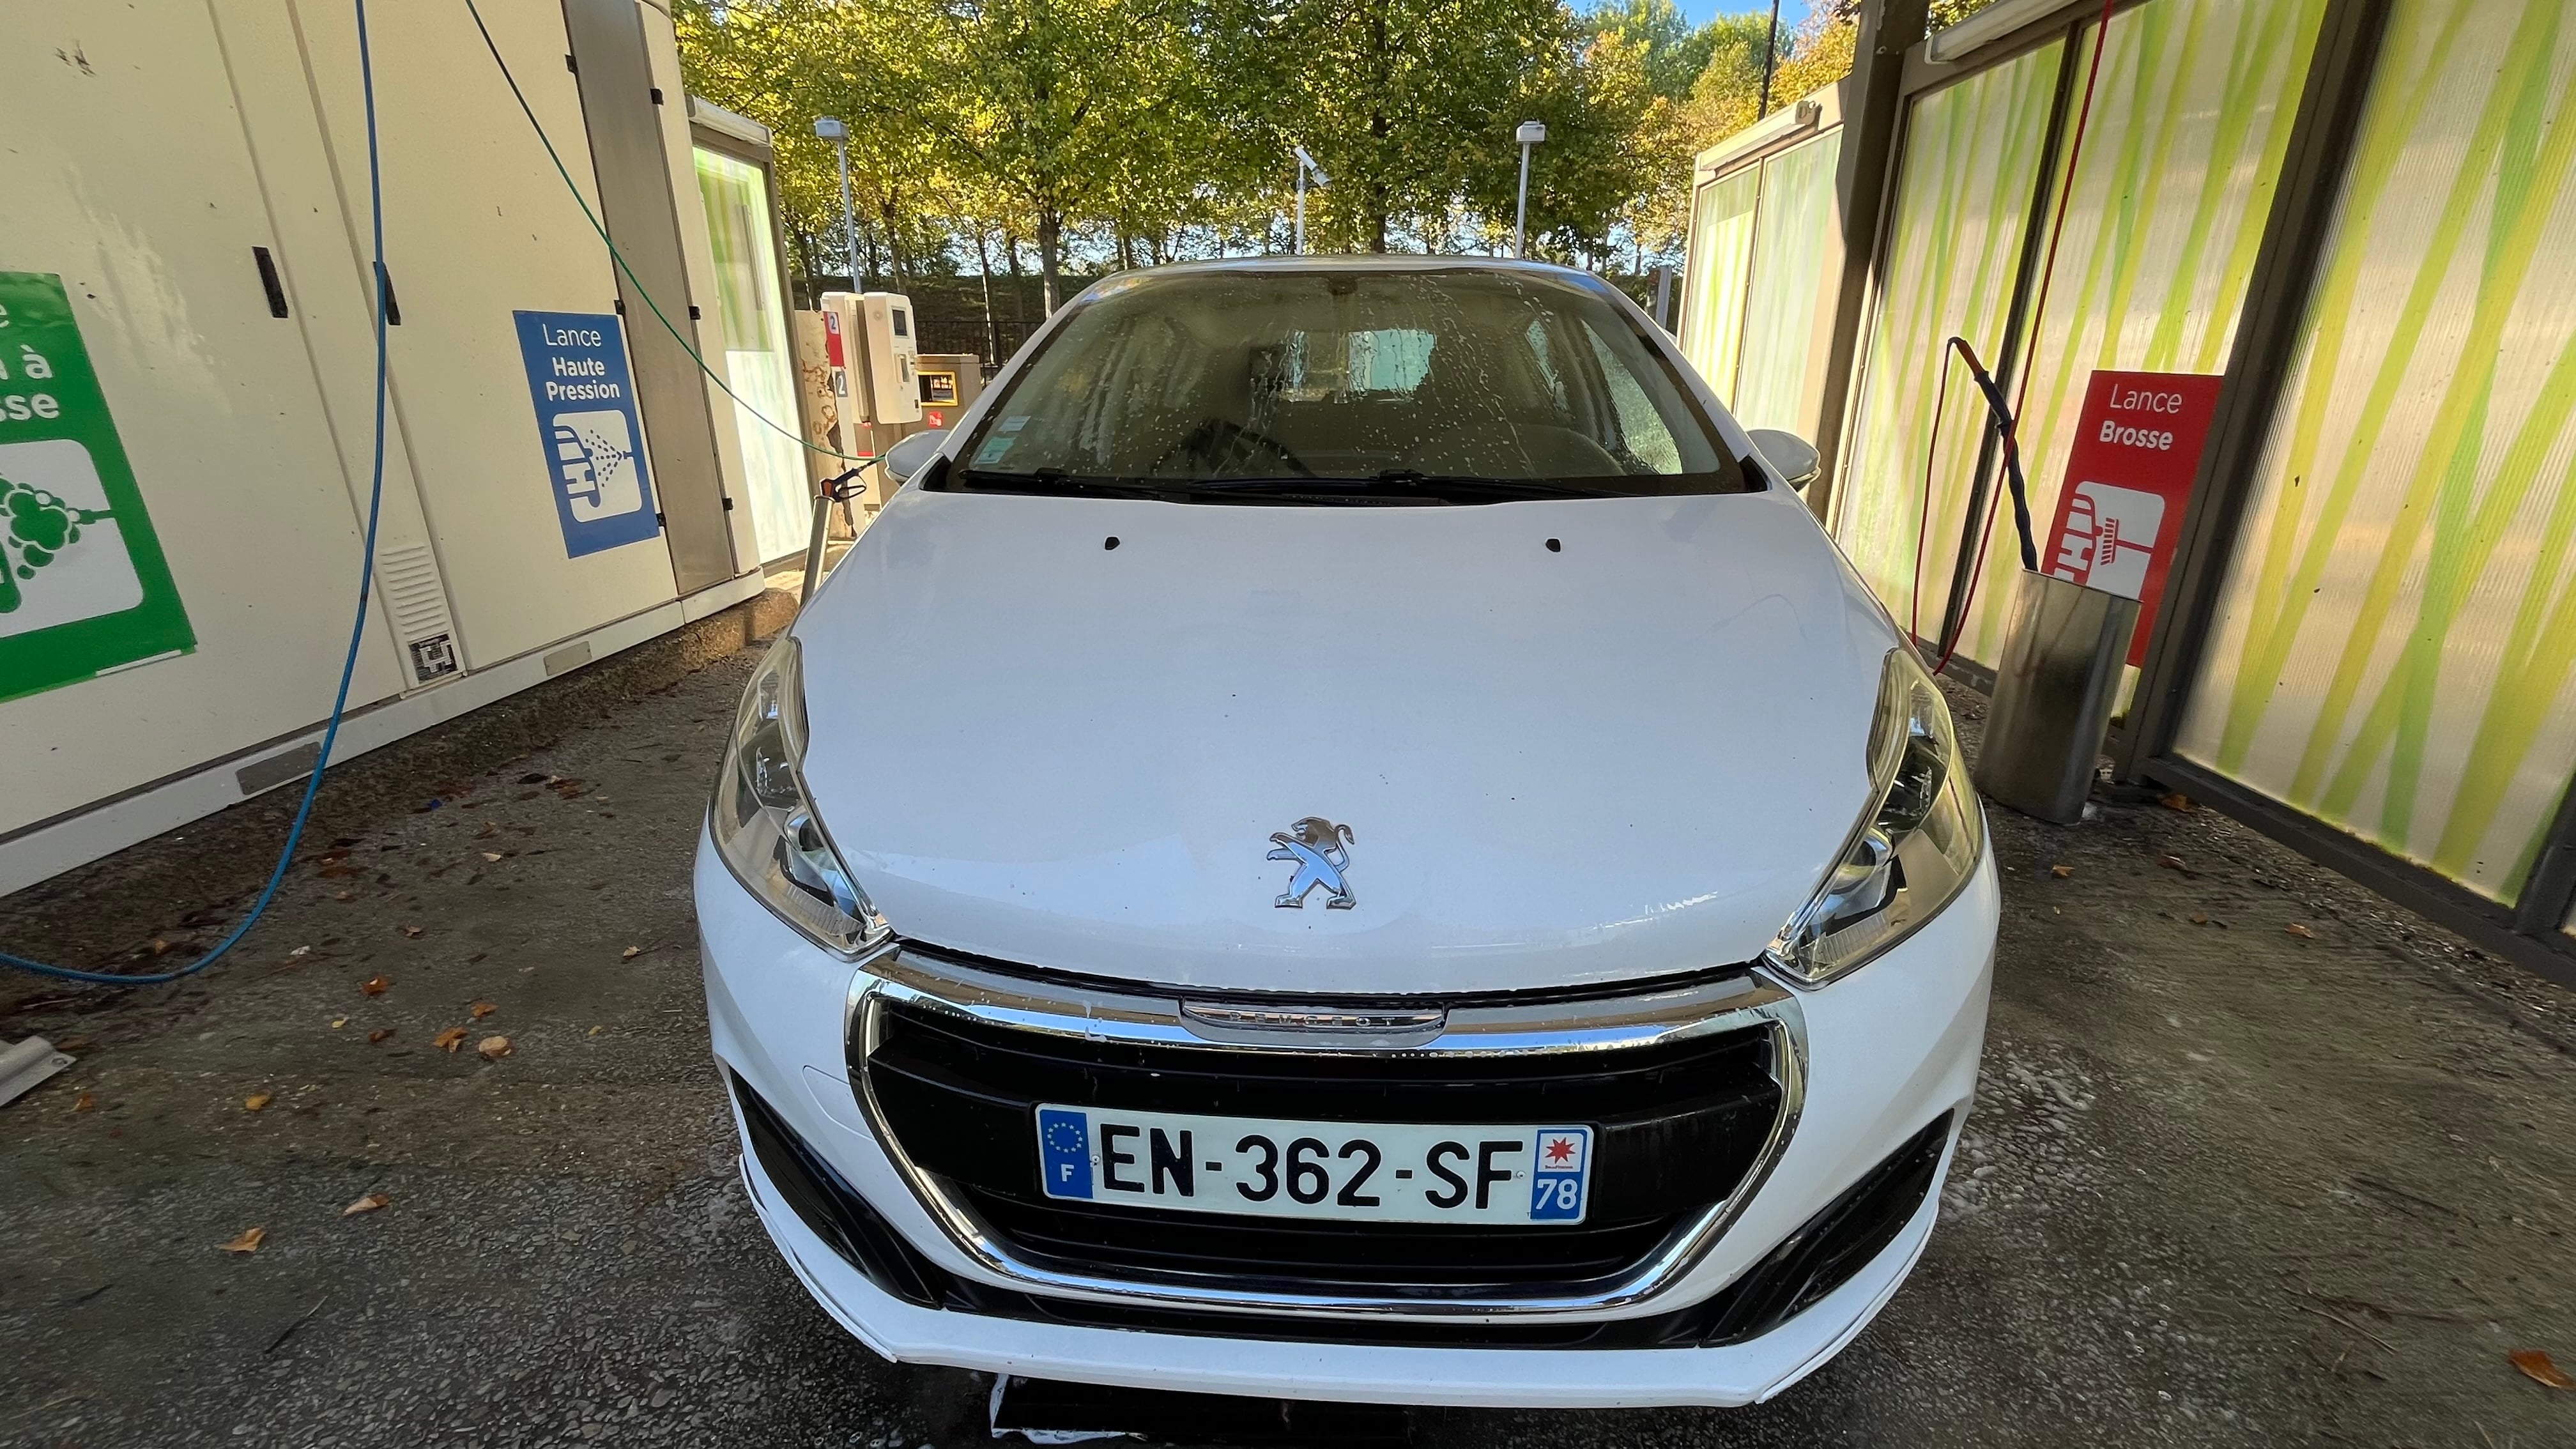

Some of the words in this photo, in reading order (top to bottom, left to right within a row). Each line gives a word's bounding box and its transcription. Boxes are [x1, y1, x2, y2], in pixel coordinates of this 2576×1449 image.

[542, 323, 602, 347] Lance
[830, 315, 836, 330] 2
[20, 344, 54, 379] à
[552, 356, 606, 377] Haute
[545, 379, 621, 402] Pression
[837, 374, 846, 395] 2
[0, 394, 60, 422] se
[2109, 383, 2183, 414] Lance
[2099, 420, 2174, 451] Brosse
[1061, 1163, 1075, 1182] F
[1099, 1123, 1524, 1209] EN-362-SF
[1535, 1178, 1578, 1210] 78
